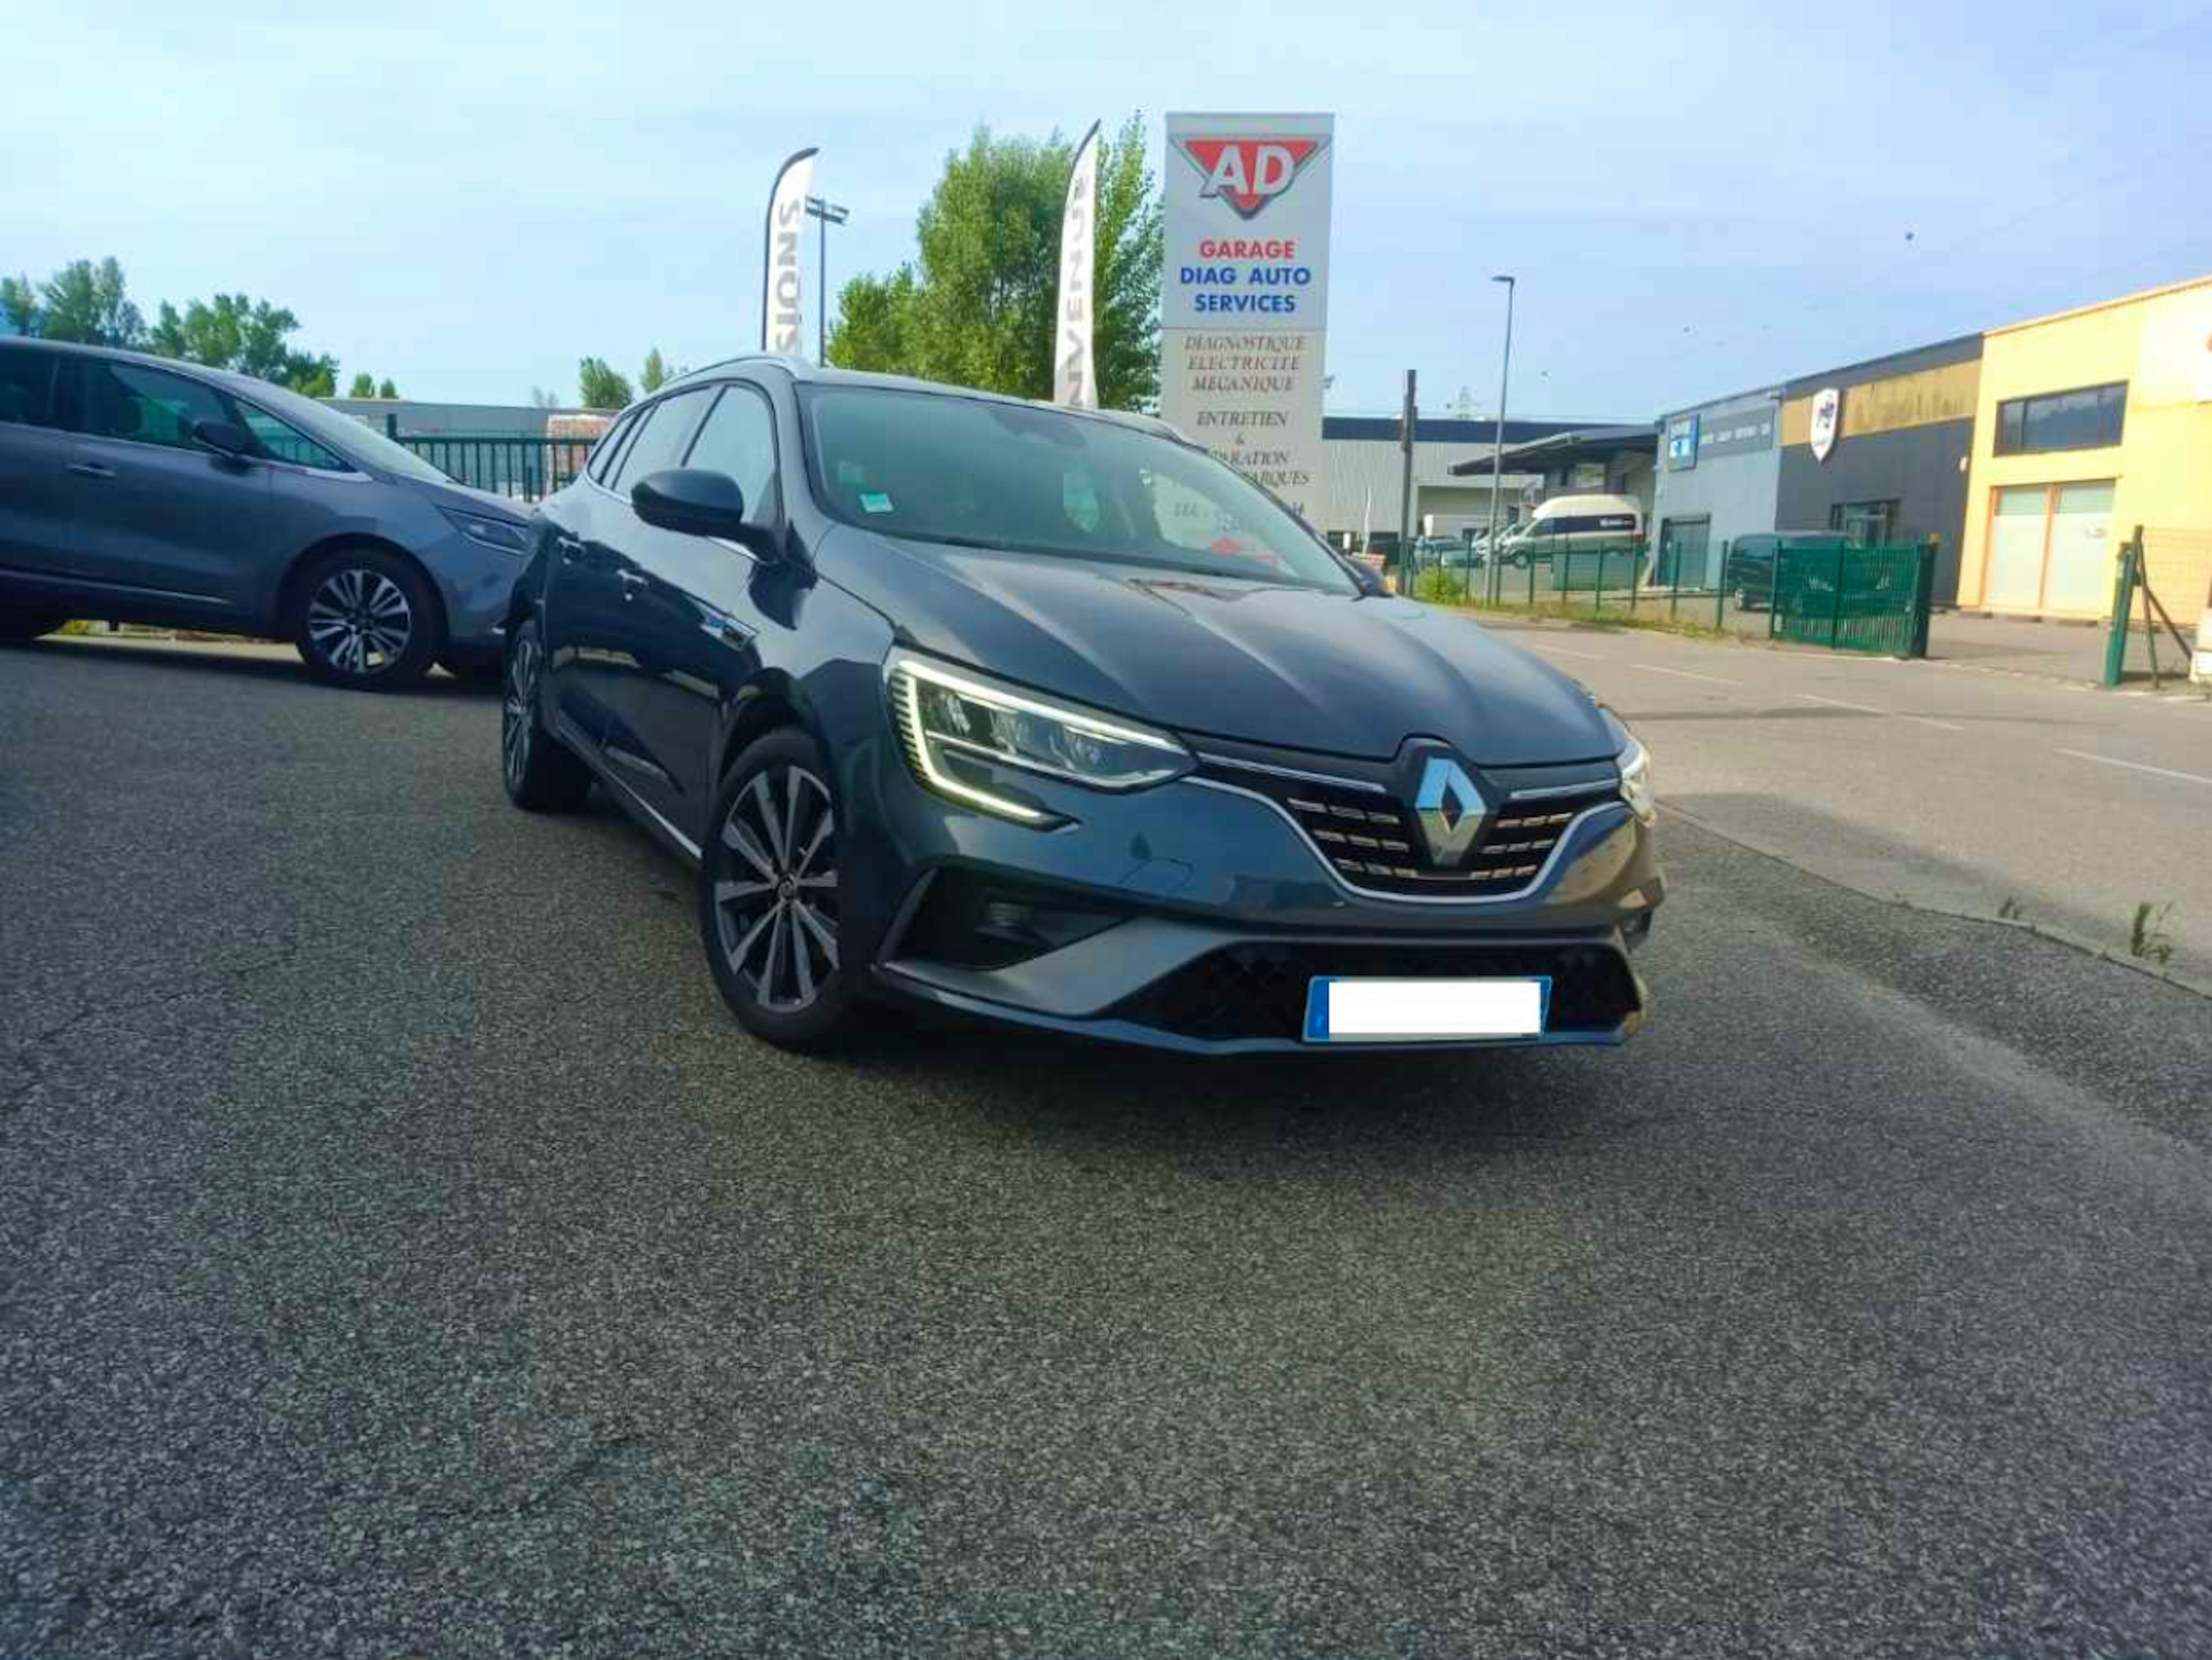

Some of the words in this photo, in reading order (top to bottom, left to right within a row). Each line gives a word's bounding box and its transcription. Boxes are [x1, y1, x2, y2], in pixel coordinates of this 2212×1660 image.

[1199, 144, 1296, 197] AD
[1199, 240, 1295, 259] GARAGE
[1181, 267, 1236, 285] DIAG
[1249, 267, 1311, 285] AUTO
[1194, 294, 1296, 312] SERVICES
[1184, 335, 1306, 352] DIAGNOSTIQUE
[1196, 411, 1289, 426] ENTRETIEN
